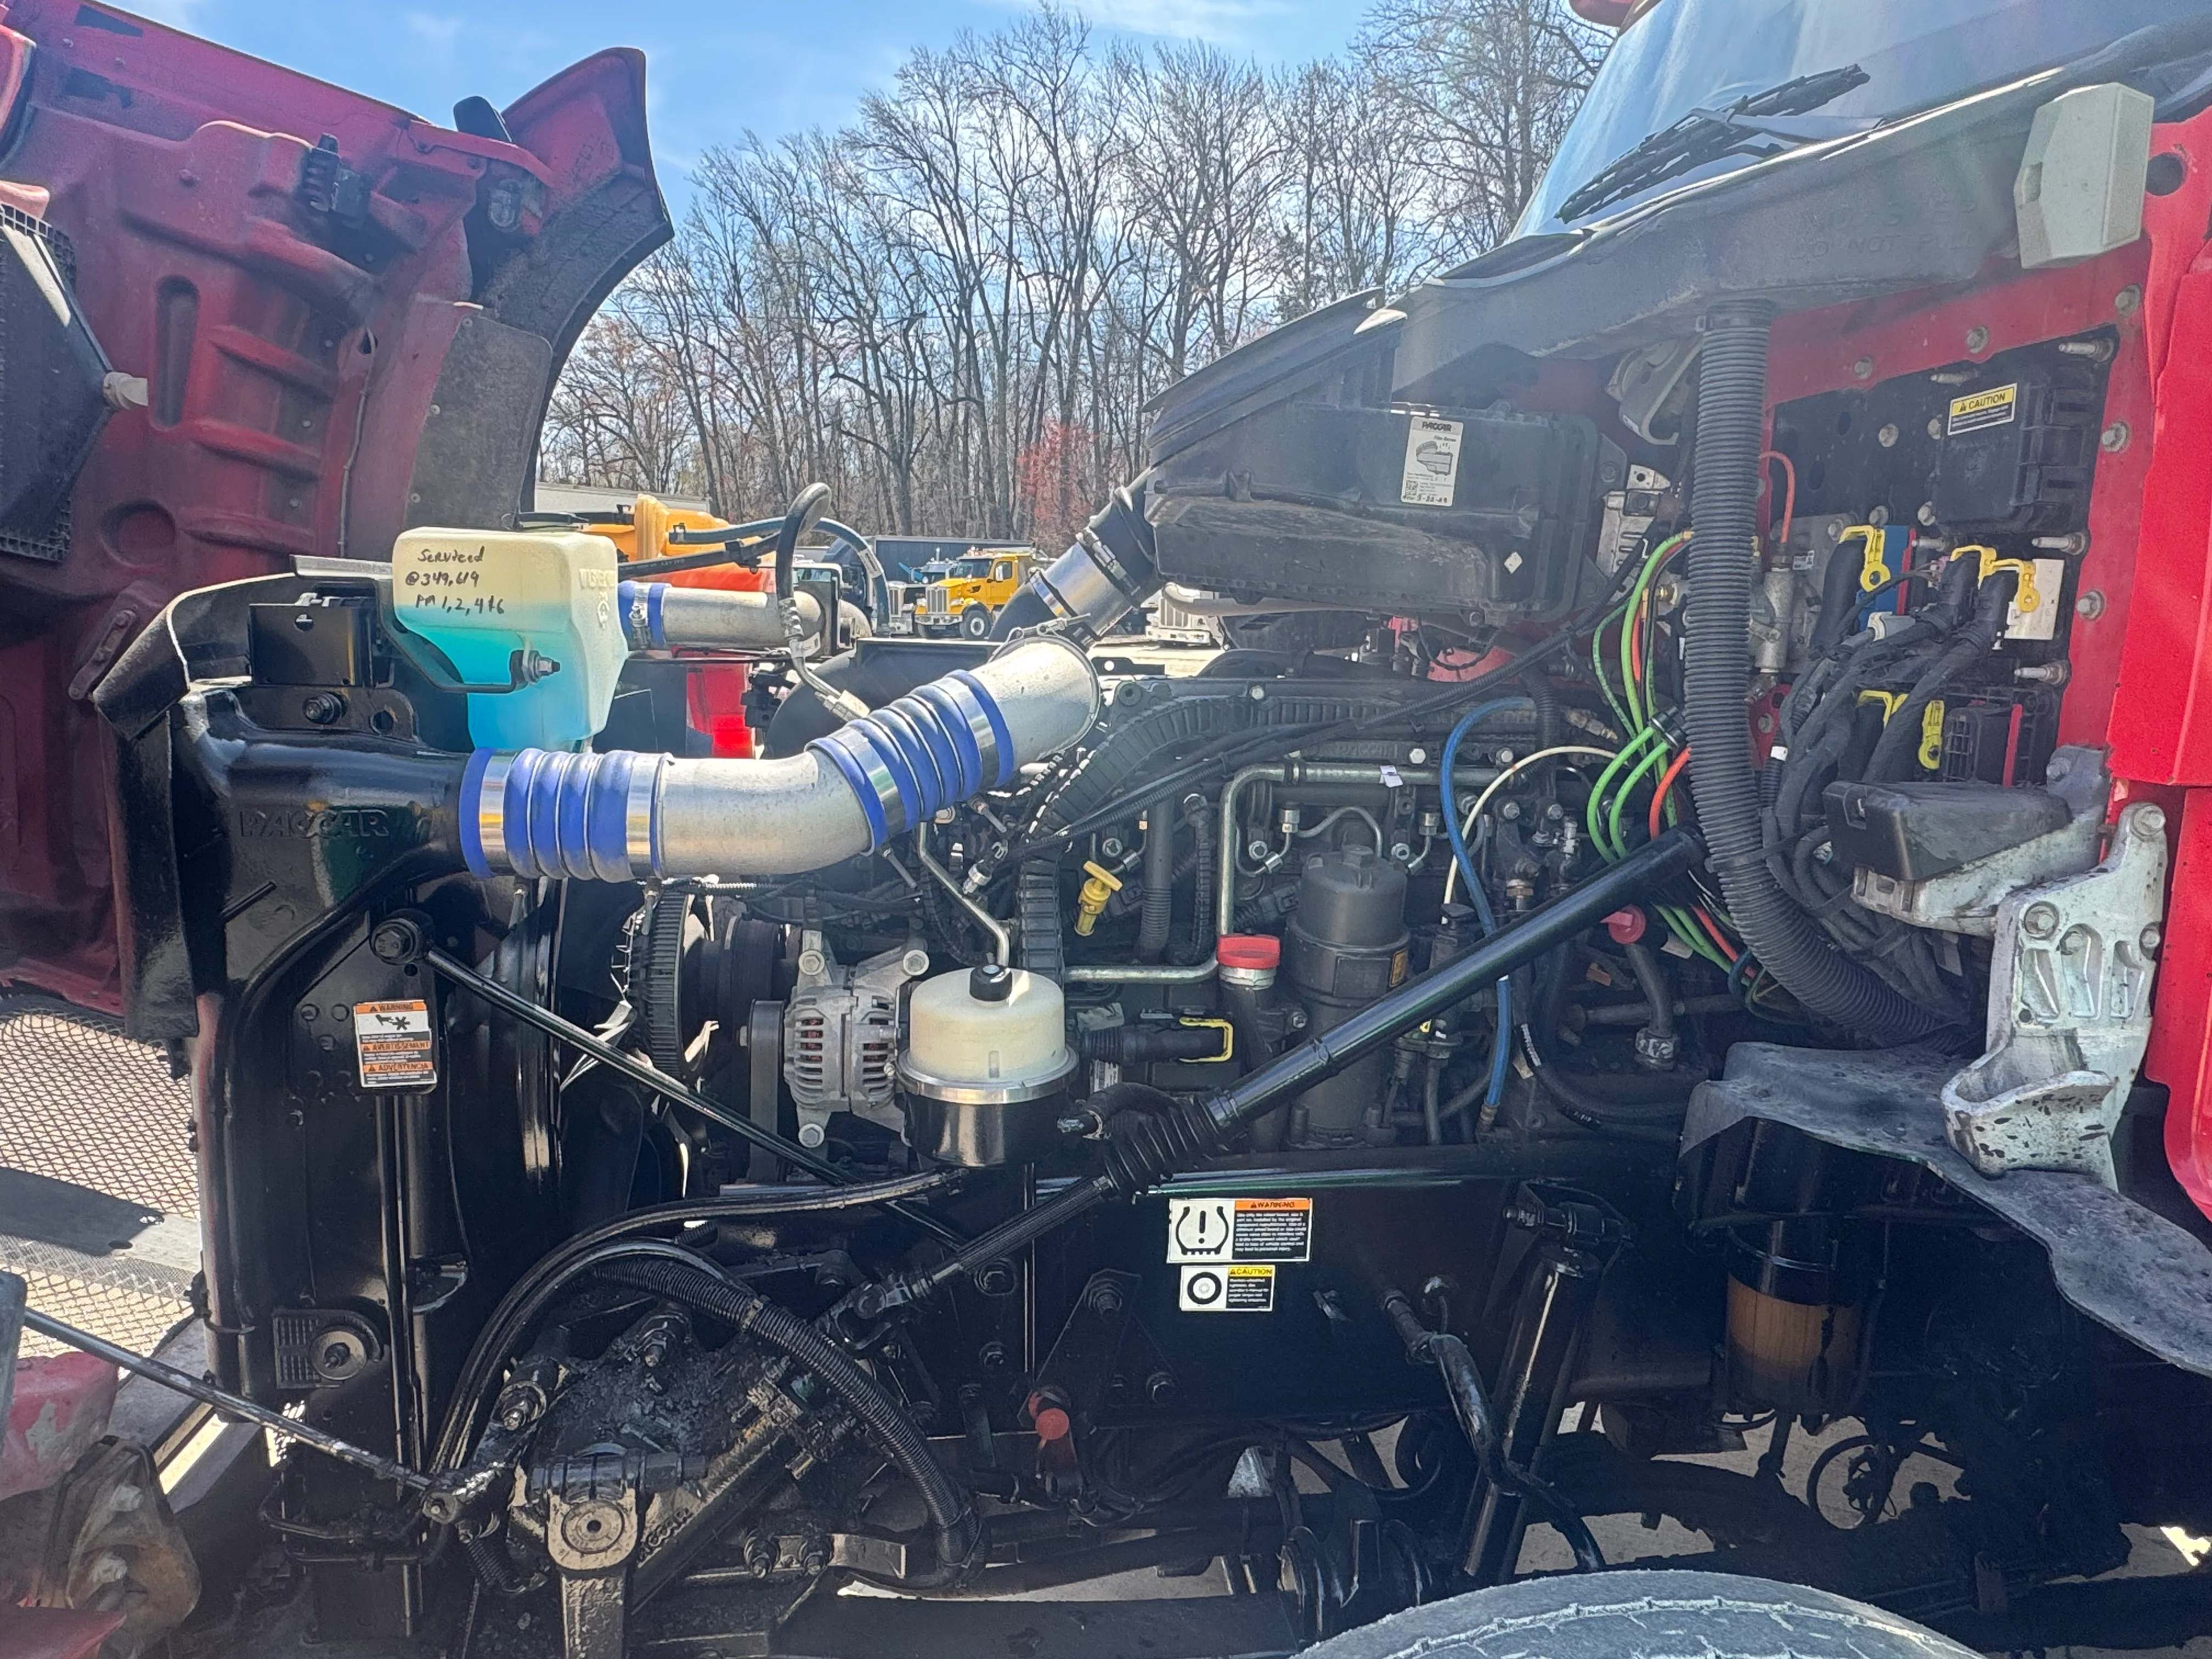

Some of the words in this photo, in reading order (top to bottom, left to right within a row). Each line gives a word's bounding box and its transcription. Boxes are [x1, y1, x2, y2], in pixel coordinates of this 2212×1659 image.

[1846, 234, 1901, 255] NOT
[1968, 392, 2006, 410] CAUTION
[1421, 421, 1452, 432] PACCAR
[239, 809, 390, 838] PACCAR
[379, 1002, 414, 1012] WARNING
